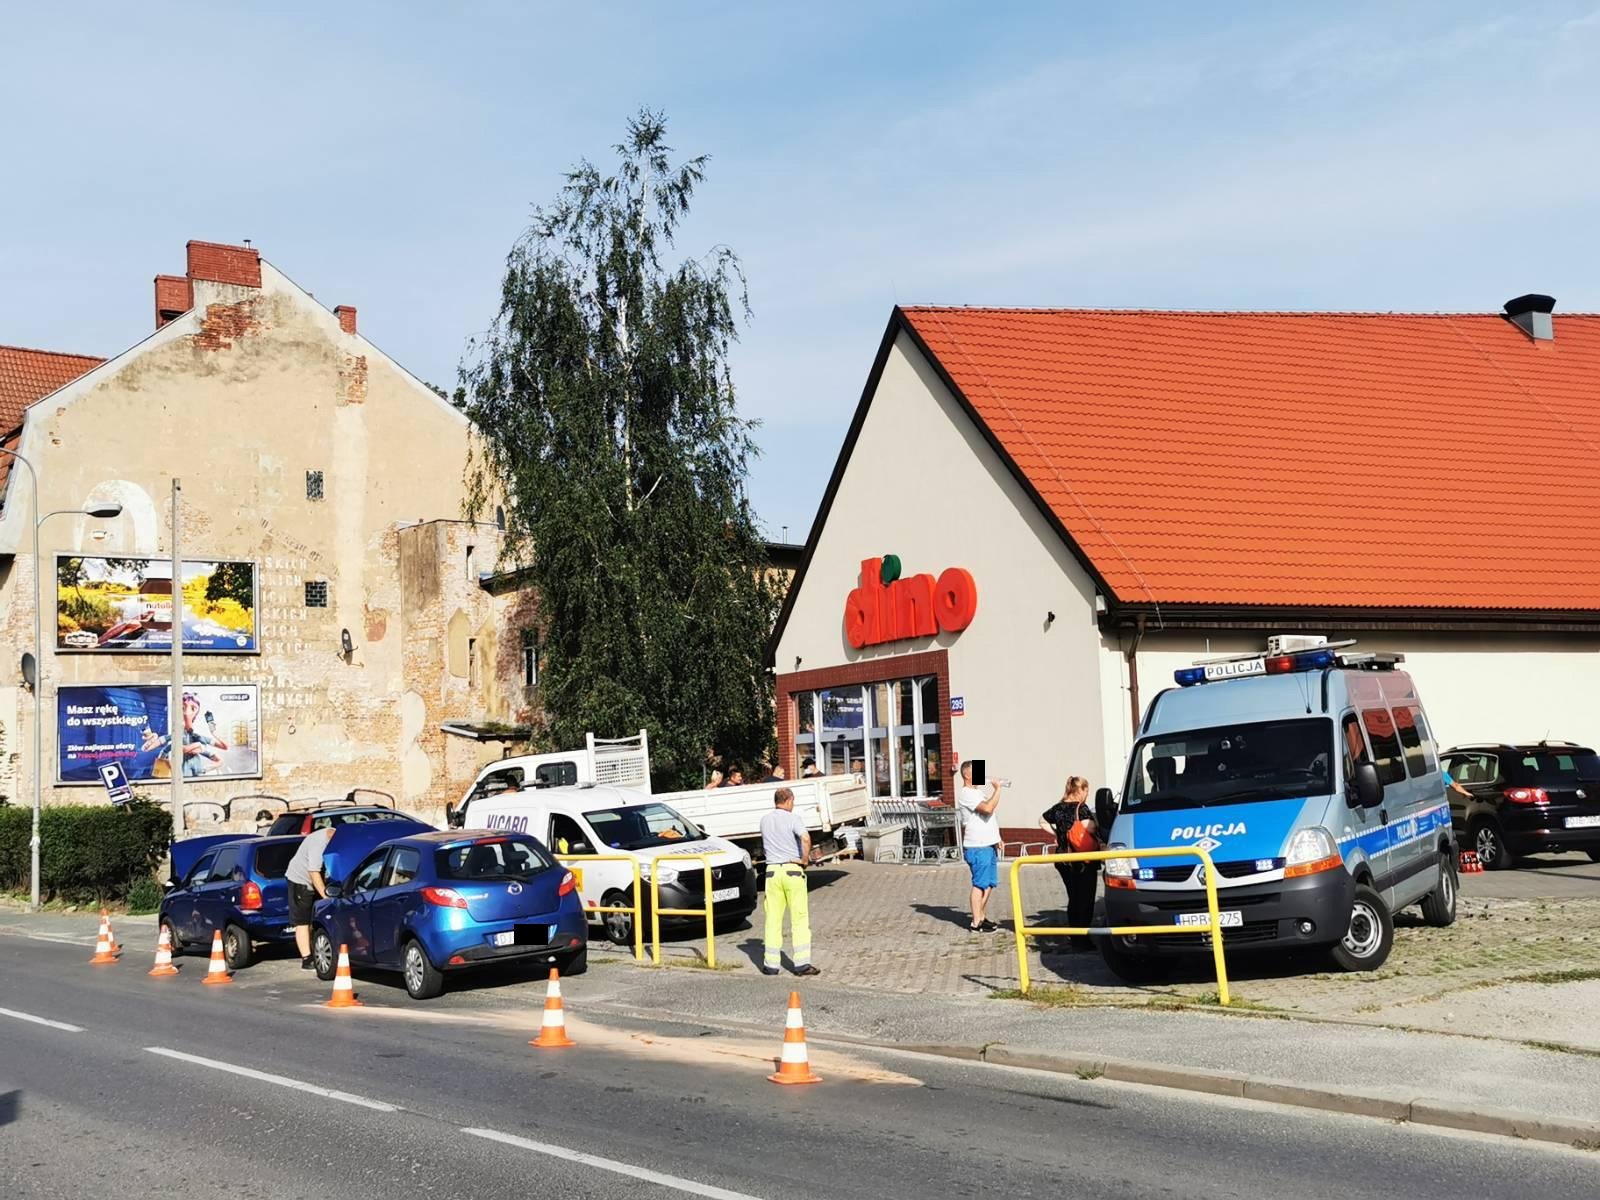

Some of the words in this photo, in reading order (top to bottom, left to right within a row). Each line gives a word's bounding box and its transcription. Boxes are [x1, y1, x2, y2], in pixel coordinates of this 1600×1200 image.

[846, 555, 977, 650] dino
[1207, 661, 1264, 677] POLICJA
[67, 705, 93, 715] Masz
[95, 704, 118, 715] rękę
[67, 717, 80, 726] do
[82, 715, 149, 727] wszystkiego?
[84, 743, 114, 752] najlepsze
[115, 743, 135, 751] oferty
[101, 765, 120, 788] P
[487, 814, 528, 834] VICARO
[1171, 822, 1246, 840] POLICJA
